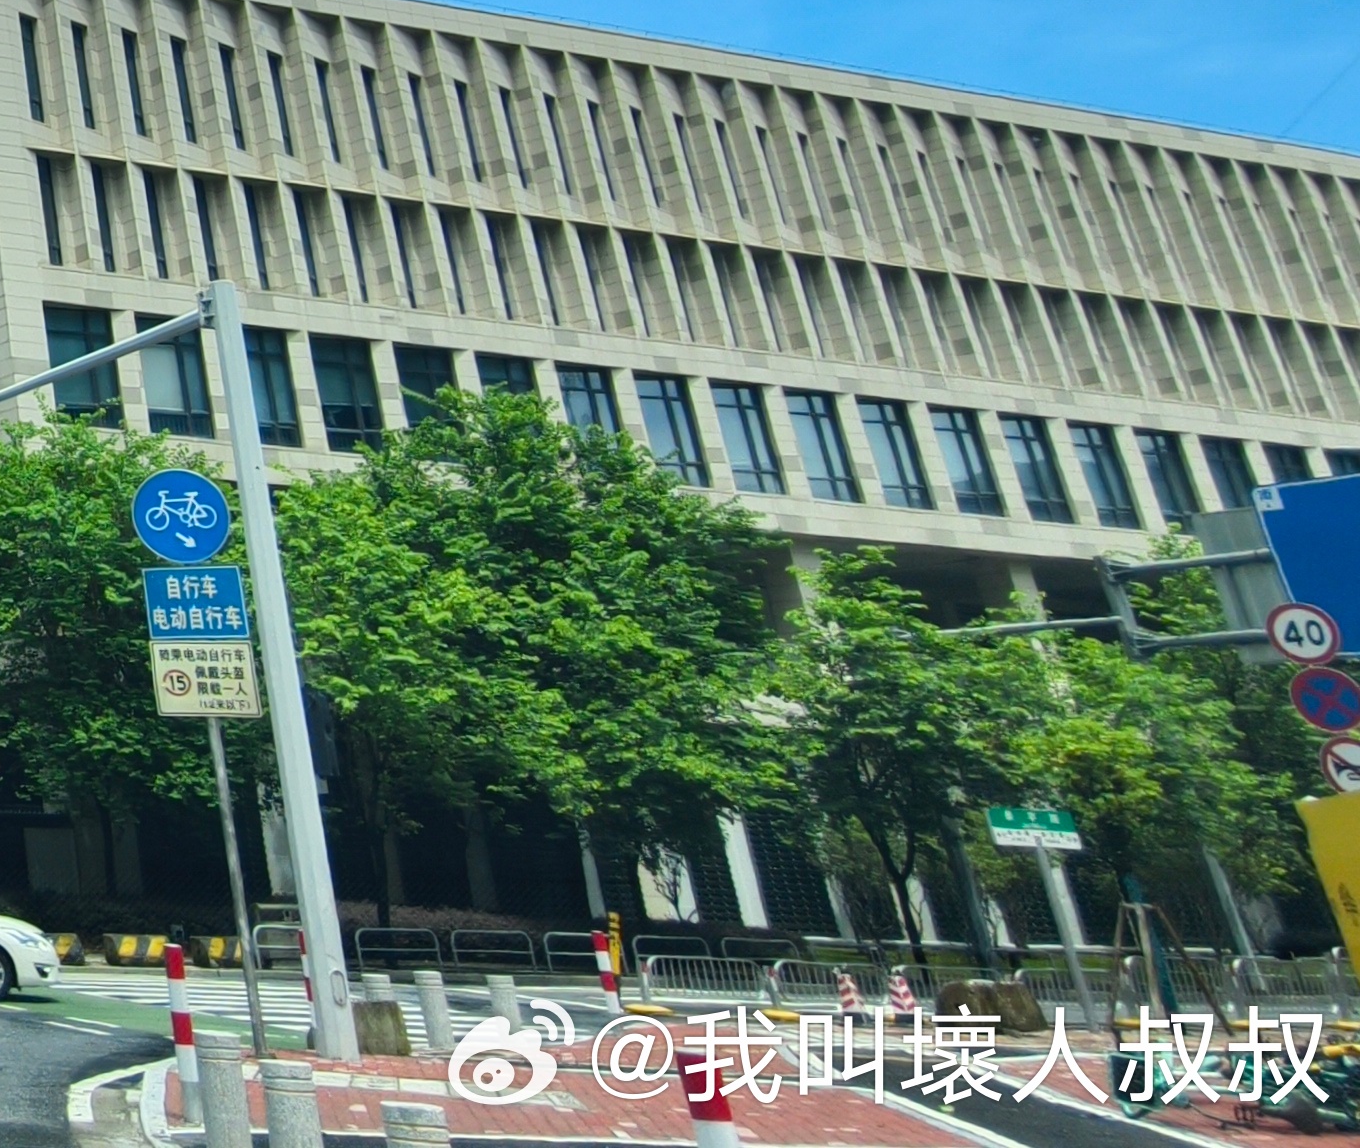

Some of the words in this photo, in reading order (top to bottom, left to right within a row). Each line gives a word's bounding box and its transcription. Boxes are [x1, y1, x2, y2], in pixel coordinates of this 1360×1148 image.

[165, 574, 218, 600] 自行车
[152, 604, 243, 631] 电动自行车
[1284, 619, 1325, 648] 40
[169, 675, 187, 691] 15
[196, 681, 248, 696] 限载一人
